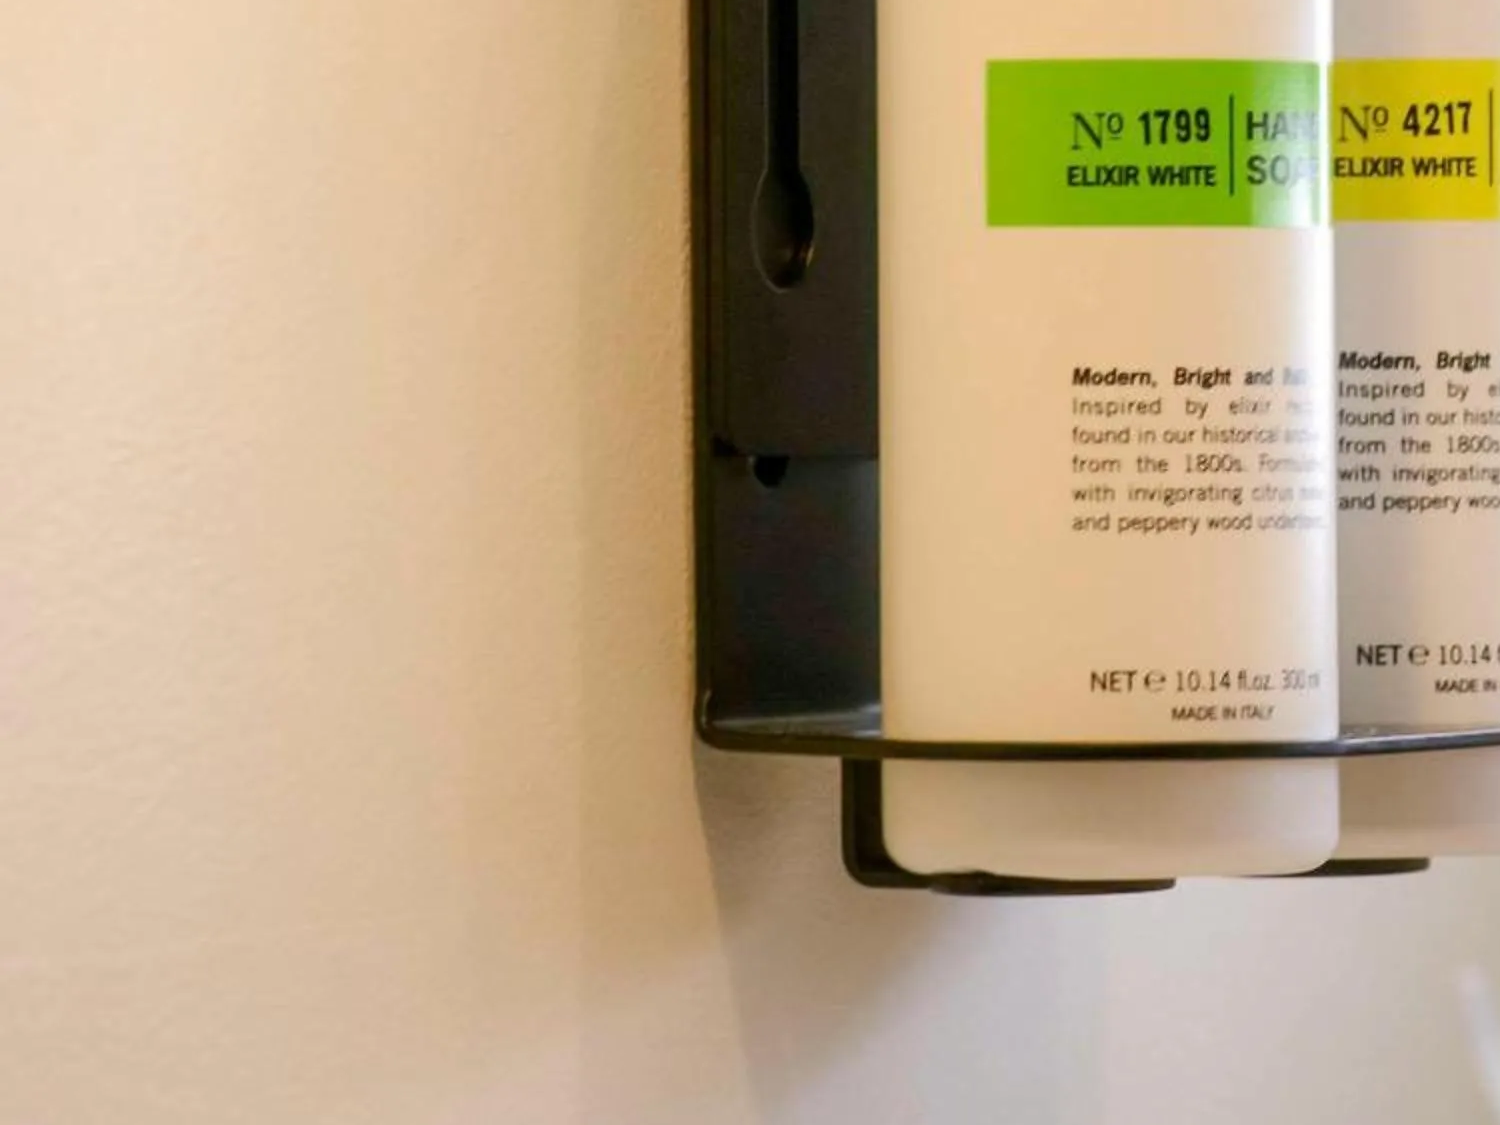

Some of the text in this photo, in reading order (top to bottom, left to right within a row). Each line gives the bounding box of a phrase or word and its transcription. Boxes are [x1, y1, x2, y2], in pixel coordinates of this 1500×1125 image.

[1138, 107, 1211, 146] 1799
[1402, 101, 1473, 136] 4217
[1067, 165, 1217, 187] ELIXIR WHITE
[1333, 156, 1478, 178] ELIXIR WHITE
[1338, 350, 1421, 373] Modern,
[1436, 350, 1491, 373] Bright
[1071, 367, 1158, 388] Modern,
[1173, 366, 1232, 389] Bright
[1243, 367, 1273, 386] and
[1338, 380, 1425, 401] Inspired
[1447, 380, 1469, 401] by
[1072, 397, 1162, 418] Inspired
[1185, 397, 1208, 419] by
[1229, 396, 1271, 416] elixir
[1338, 408, 1394, 426] found
[1402, 408, 1420, 426] in
[1426, 411, 1457, 426] our
[1072, 426, 1131, 444] found
[1138, 427, 1155, 444] in
[1162, 429, 1195, 444] our
[1338, 436, 1386, 454] from
[1401, 436, 1432, 454] the
[1072, 455, 1121, 473] from
[1137, 455, 1169, 473] the
[1338, 464, 1380, 482] with
[1072, 485, 1115, 503] with
[1128, 484, 1243, 506] invigorating
[1338, 493, 1375, 511] and
[1382, 494, 1461, 513] peppery
[1072, 514, 1110, 532] and
[1117, 516, 1200, 535] peppery
[1206, 514, 1252, 531] wood
[1356, 644, 1402, 666] NET
[1439, 644, 1492, 666] 10.14
[1090, 670, 1137, 692] NET
[1176, 669, 1232, 692] 10.14
[1434, 678, 1479, 693] MADE
[1483, 678, 1498, 692] IN
[1171, 705, 1275, 721] MADE IN ITALY
